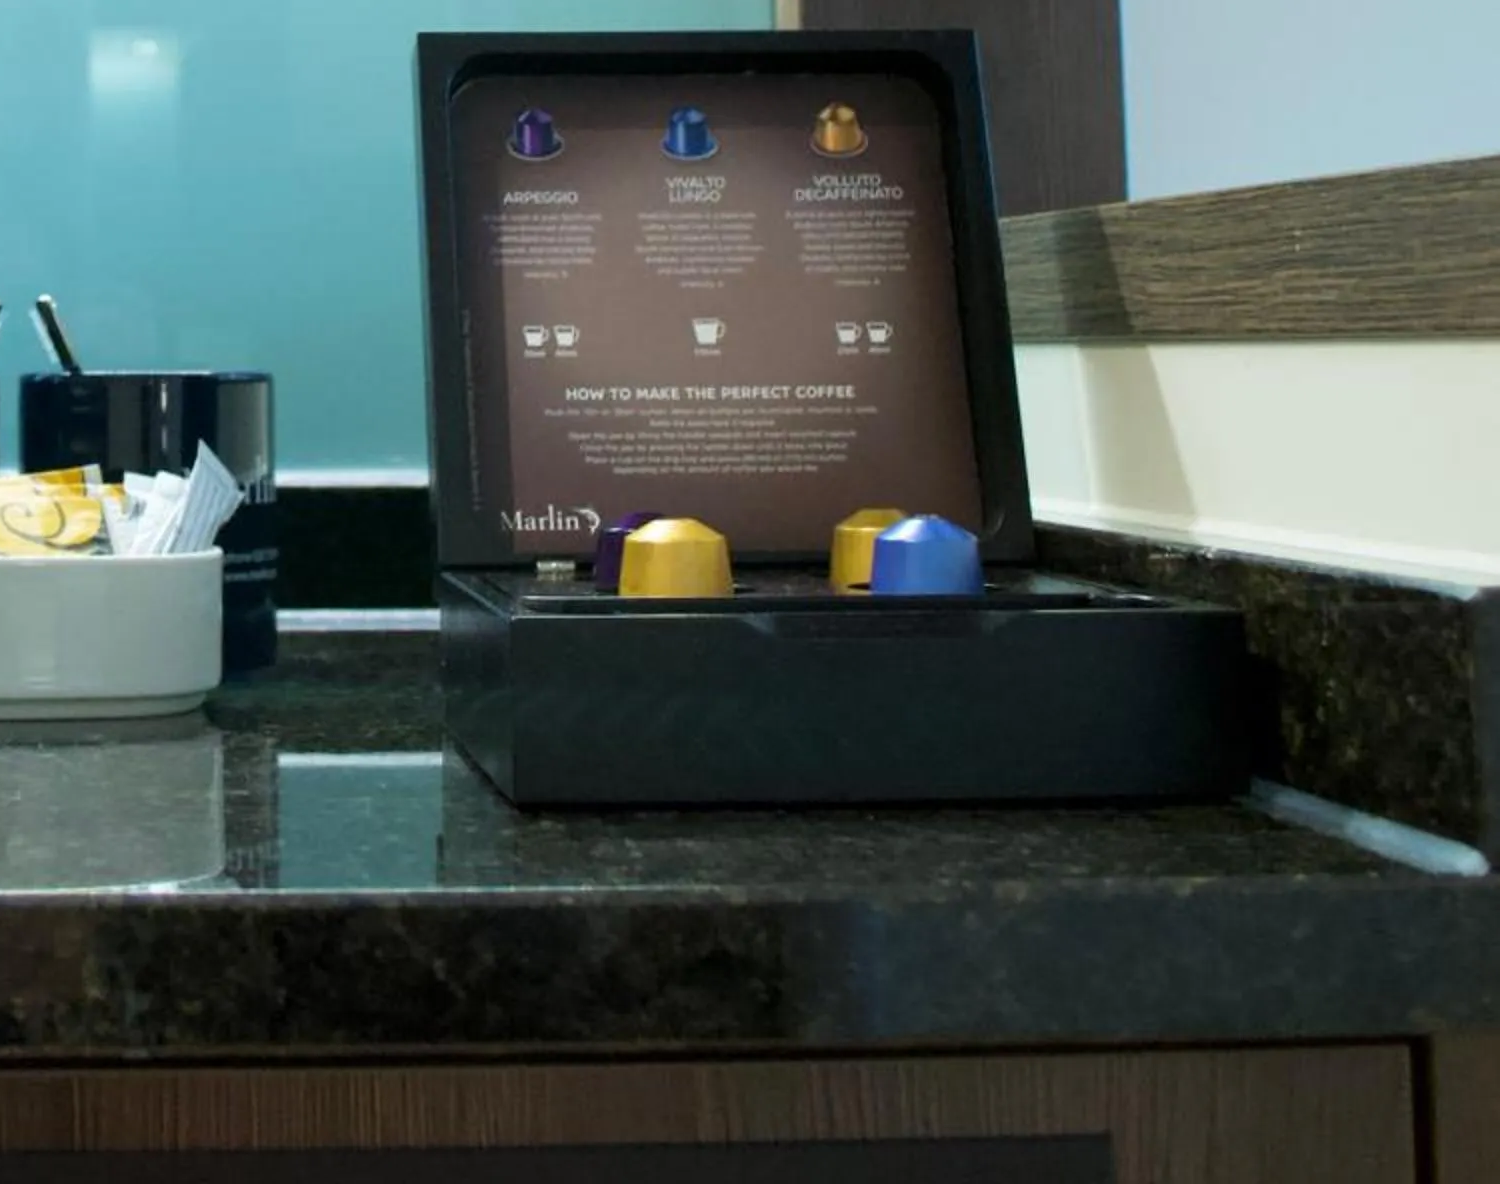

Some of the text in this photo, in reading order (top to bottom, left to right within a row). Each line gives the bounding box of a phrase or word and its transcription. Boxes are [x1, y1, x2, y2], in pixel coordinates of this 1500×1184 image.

[664, 176, 727, 189] VIVALTO
[812, 173, 882, 187] VOLLUTO
[503, 191, 580, 205] ARPEGGIO
[668, 189, 722, 203] LUNGO
[794, 186, 904, 201] DECAFFEINATO
[565, 384, 856, 401] HOW TO MAKE THE PERFECT COFFEE
[500, 504, 581, 531] Marlin
